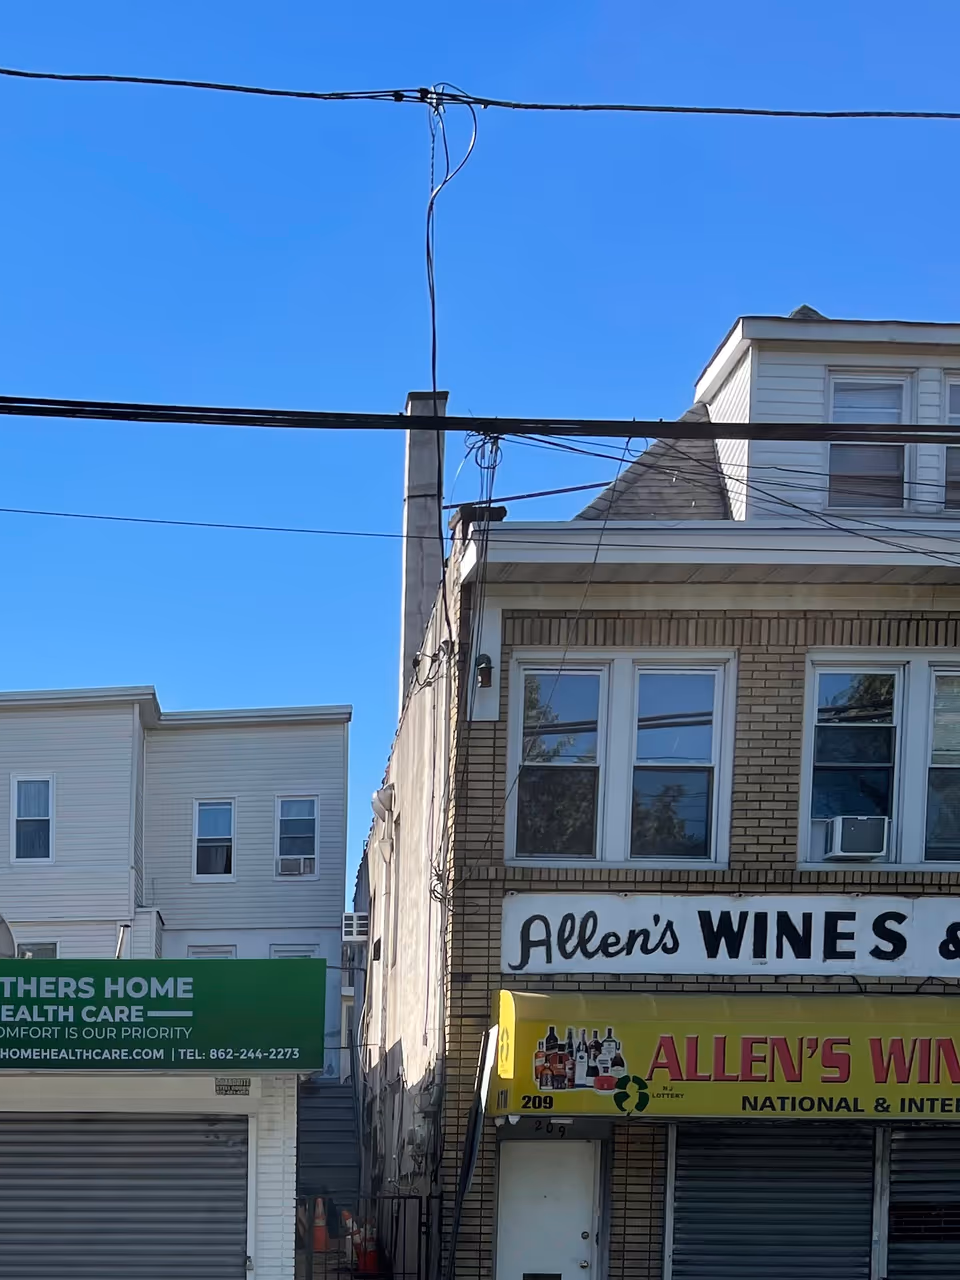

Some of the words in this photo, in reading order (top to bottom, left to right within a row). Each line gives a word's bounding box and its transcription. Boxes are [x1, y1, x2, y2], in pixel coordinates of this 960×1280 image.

[508, 910, 680, 971] Allen's
[697, 910, 909, 960] WINES
[104, 977, 194, 999] HOME
[81, 1005, 144, 1022] CARE
[65, 1027, 78, 1039] IS
[82, 1027, 117, 1040] OUR
[121, 1027, 193, 1040] PRIORITY
[178, 1049, 206, 1060] TEL:
[209, 1048, 300, 1060] 862-244-2273
[645, 1034, 851, 1082] ALLEN'S
[521, 1095, 554, 1109] 209
[741, 1096, 865, 1112] NATIONAL
[873, 1098, 892, 1112] &
